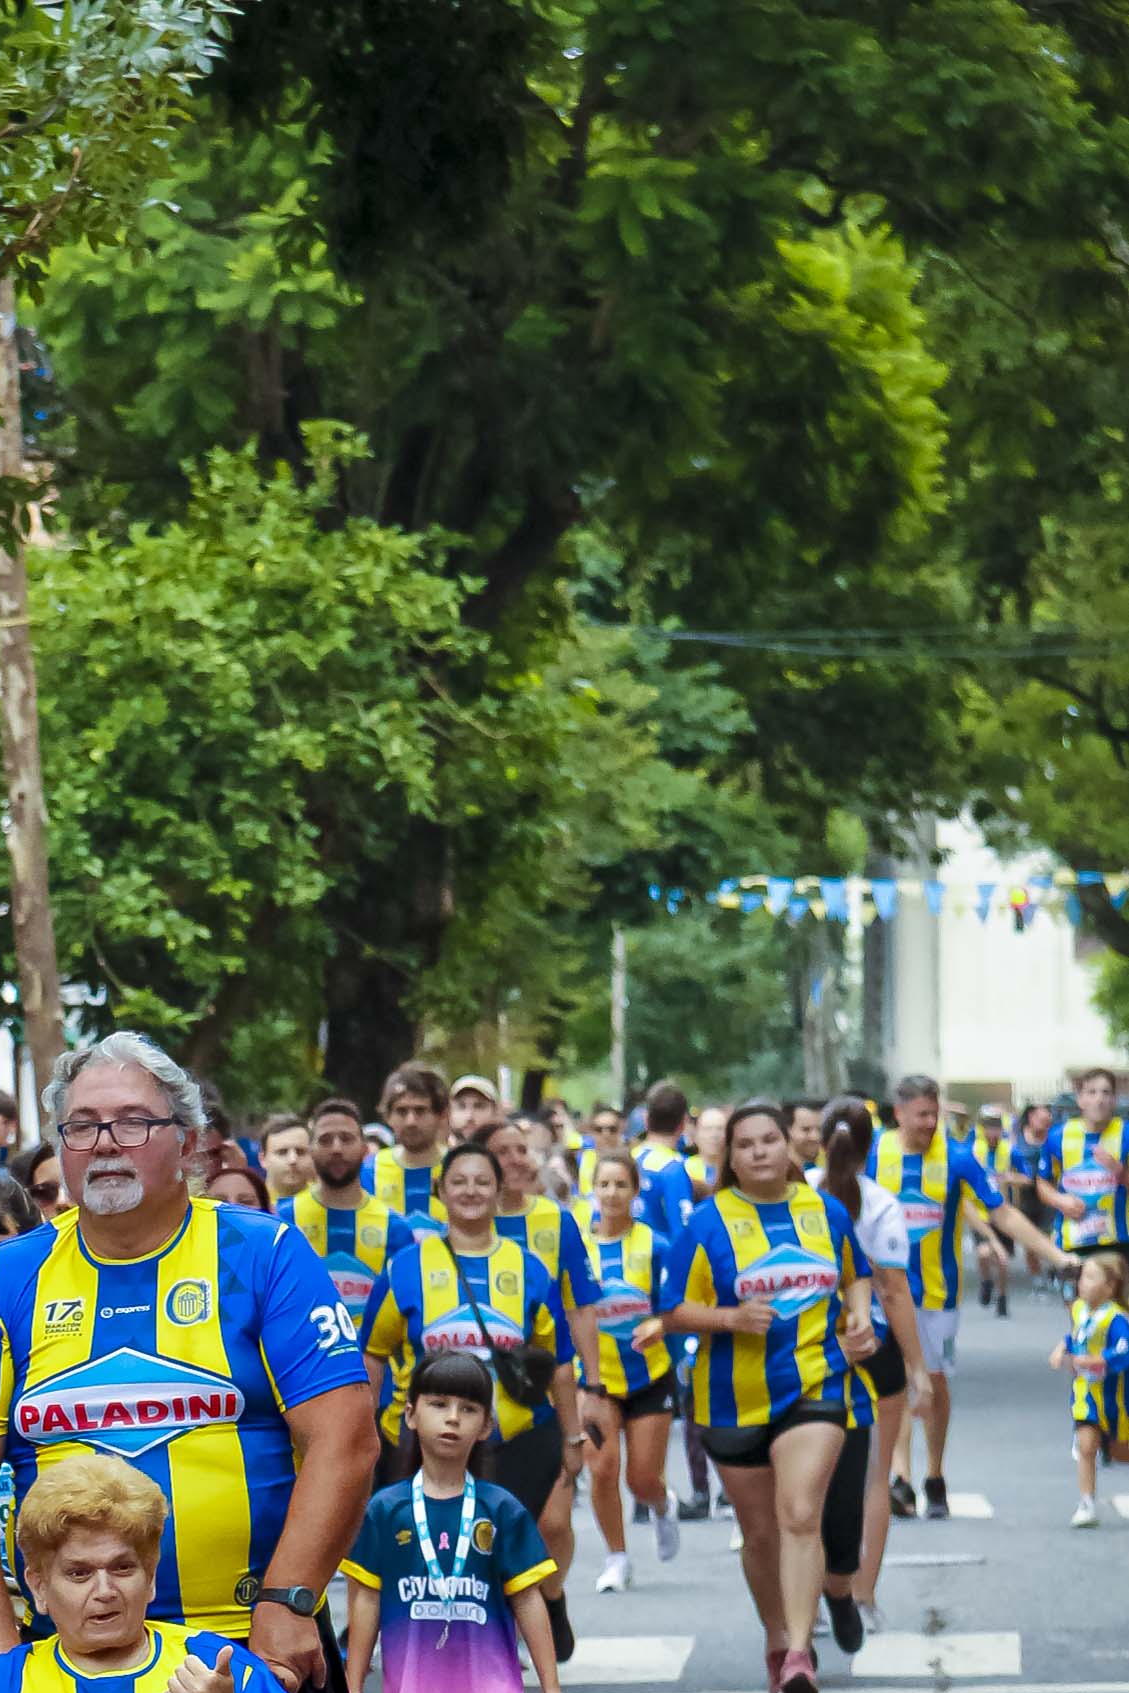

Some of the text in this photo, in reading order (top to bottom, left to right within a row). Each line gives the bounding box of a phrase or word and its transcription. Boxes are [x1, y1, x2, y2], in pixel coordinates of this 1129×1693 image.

[115, 1304, 150, 1314] express
[310, 1302, 357, 1350] 30
[21, 1393, 236, 1434] PALADINI
